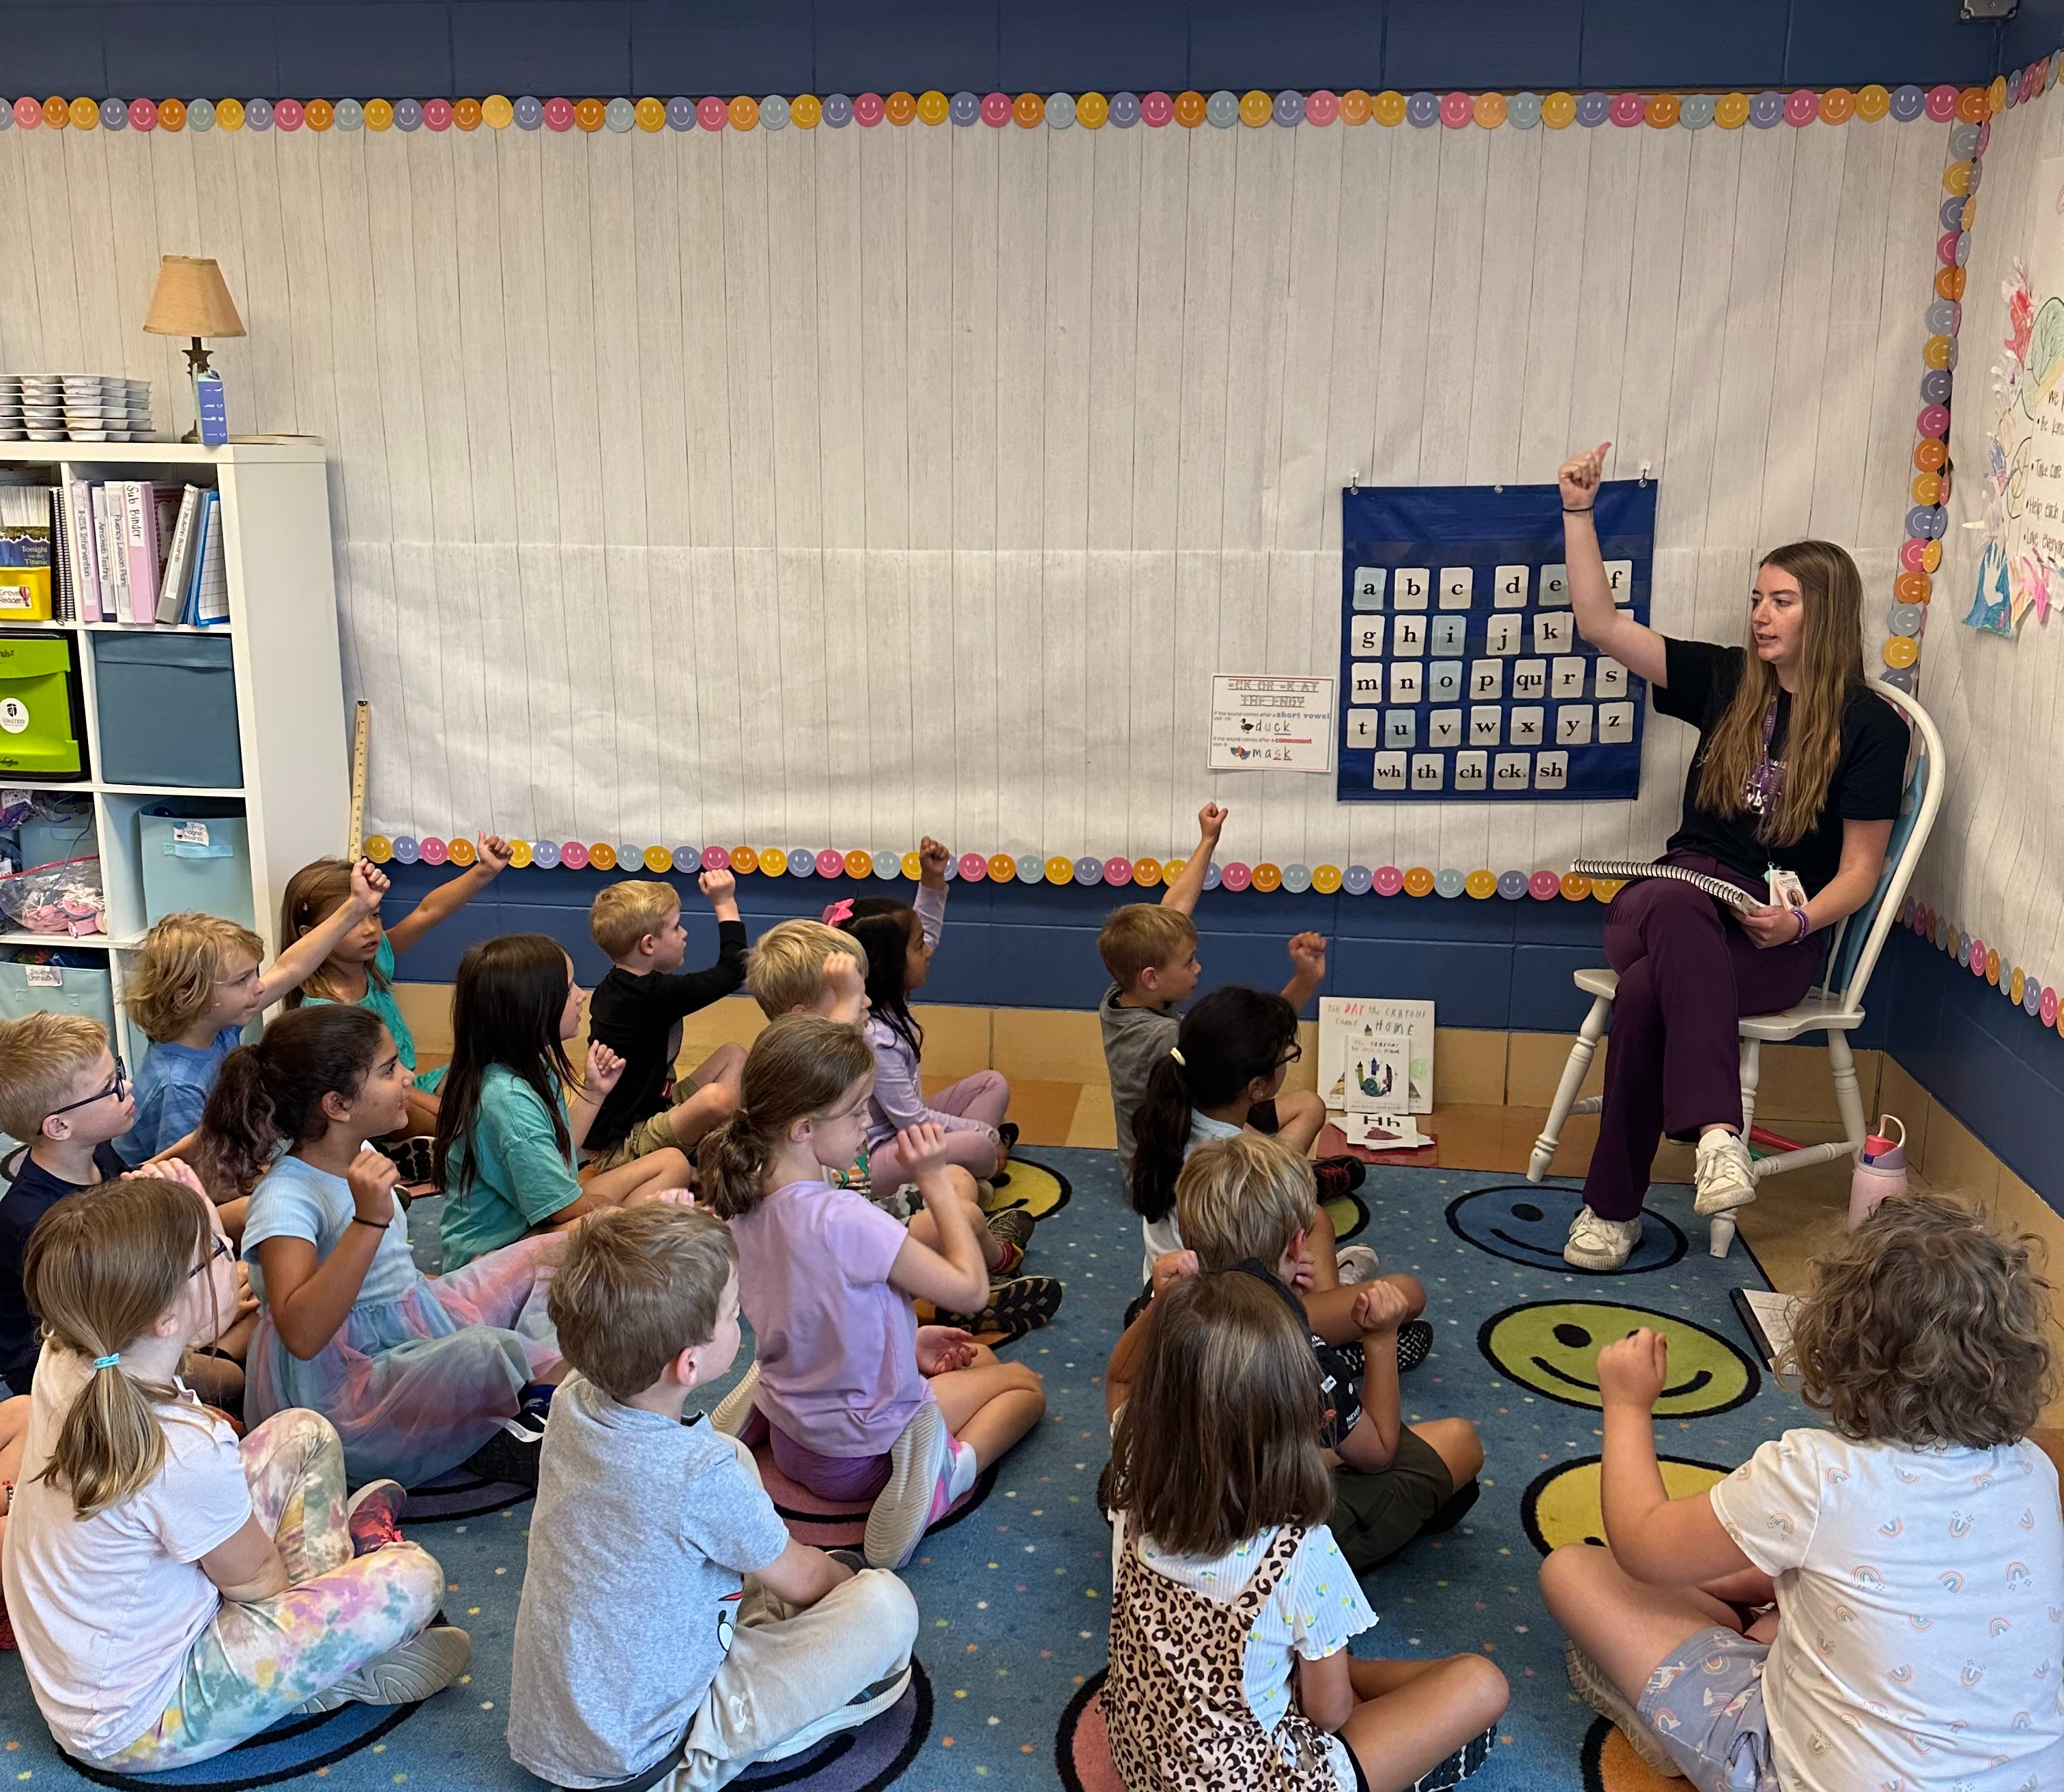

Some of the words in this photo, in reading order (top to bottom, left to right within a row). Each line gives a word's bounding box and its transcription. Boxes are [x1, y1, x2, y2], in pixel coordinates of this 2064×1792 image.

[2035, 458, 2048, 480] Take
[2050, 463, 2061, 479] care
[126, 485, 139, 504] Sub
[2029, 496, 2042, 521] Help
[114, 514, 122, 541] Fluency
[130, 509, 143, 539] Binder
[21, 545, 48, 554] Tonight
[81, 532, 91, 577] Intervention
[1364, 584, 1376, 595] a
[1407, 578, 1420, 595] b
[1452, 584, 1463, 595] c
[1506, 576, 1520, 593] d
[1549, 580, 1561, 591] e
[1610, 571, 1622, 588] f
[1362, 632, 1376, 648] g
[1403, 626, 1416, 642] h
[1446, 627, 1453, 642] i
[1497, 629, 1507, 651] j
[1543, 623, 1558, 640] k
[1258, 680, 1274, 691] OR
[1301, 682, 1319, 692] AT
[1357, 679, 1378, 690] m
[1400, 679, 1414, 689] n
[1440, 677, 1452, 687] o
[1478, 676, 1493, 691] p
[1517, 675, 1542, 687] qu
[1563, 674, 1575, 684] r
[1606, 671, 1617, 682] s
[1240, 695, 1265, 706] THE
[1255, 719, 1290, 733] duck
[1360, 722, 1366, 735] t
[1394, 725, 1408, 735] u
[1439, 725, 1451, 735] v
[1476, 723, 1496, 733] w
[1521, 722, 1534, 733] x
[1566, 721, 1579, 737] y
[1609, 716, 1620, 727] z
[1252, 746, 1291, 759] mask
[1377, 765, 1401, 777] wh
[1418, 765, 1437, 778] th
[1460, 764, 1482, 778] ch
[1498, 764, 1521, 778] ck
[1540, 763, 1563, 777] sh
[1779, 877, 1798, 885] UNITED
[1344, 1003, 1366, 1015] DAY
[1368, 1005, 1381, 1016] the
[1385, 1007, 1426, 1019] CRAYONS
[1375, 1019, 1415, 1036] HOME
